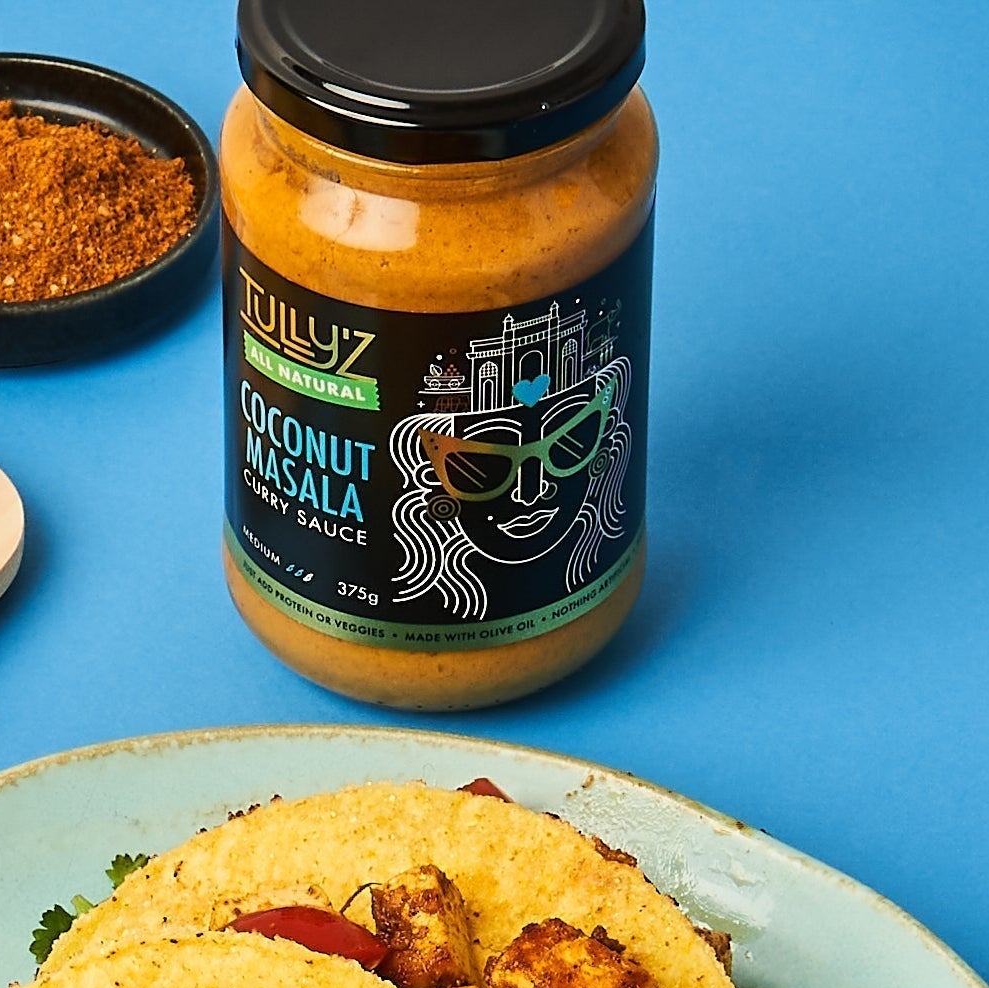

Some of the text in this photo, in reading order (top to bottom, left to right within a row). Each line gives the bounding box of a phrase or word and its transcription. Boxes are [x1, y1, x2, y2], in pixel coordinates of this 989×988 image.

[250, 345, 366, 402] ALL NATURAL
[241, 380, 376, 481] COCONUT
[243, 468, 368, 546] CURRY SAUCE
[246, 426, 364, 523] MASALA
[242, 525, 281, 566] MEDIUM
[257, 577, 273, 594] ADD
[275, 590, 313, 618] PROTEIN
[316, 613, 331, 626] OR
[335, 619, 386, 638] VEGGIES
[405, 632, 440, 643] MADE
[444, 630, 476, 642] WITH
[479, 624, 513, 639] OLIVE
[516, 618, 535, 632] OIL
[551, 588, 597, 620] NOTHING
[337, 581, 379, 606] 375g
